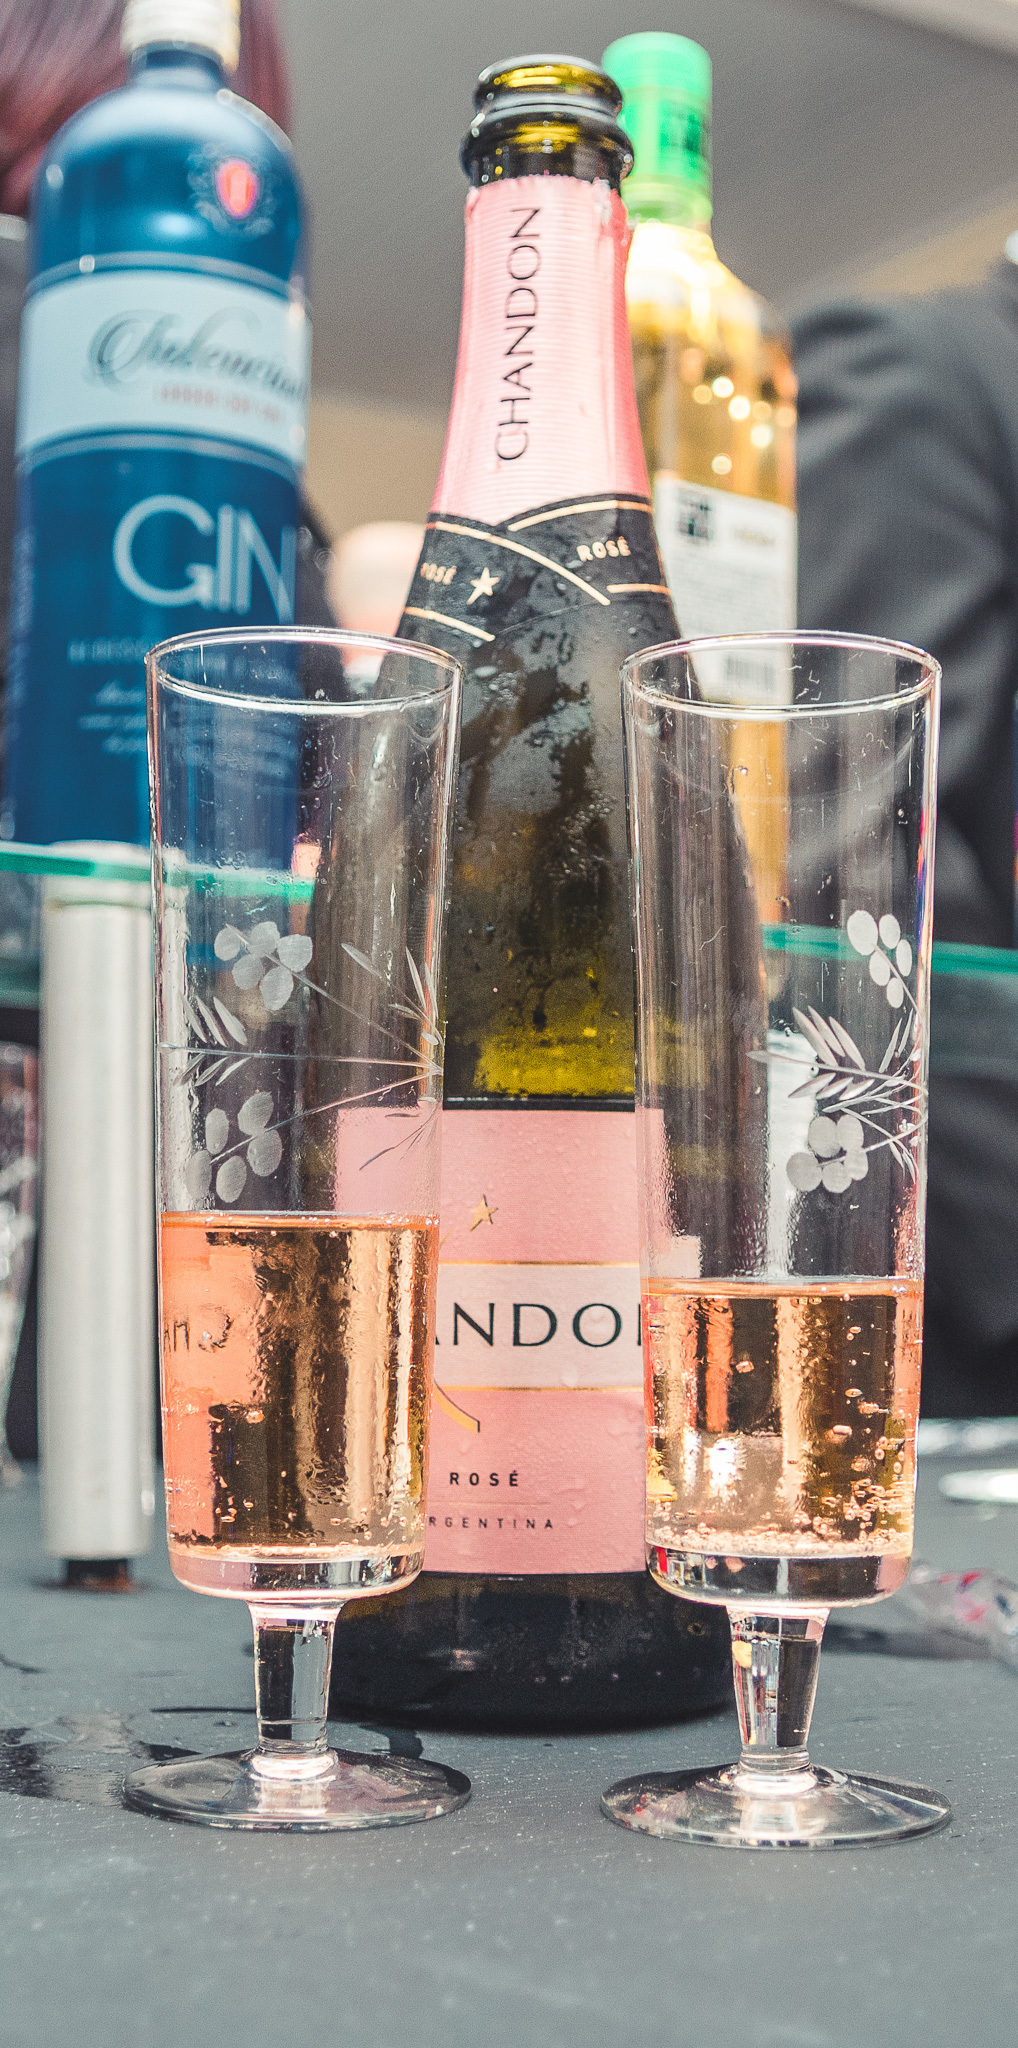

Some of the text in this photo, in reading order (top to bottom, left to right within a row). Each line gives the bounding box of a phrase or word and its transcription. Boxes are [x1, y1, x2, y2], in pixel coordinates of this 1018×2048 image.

[494, 207, 542, 462] CHANDON
[112, 494, 298, 625] GIN
[576, 535, 631, 563] ROSÉ
[435, 1302, 642, 1348] NDO
[449, 1470, 519, 1487] ROSÉ
[428, 1516, 554, 1530] RGENTINA
